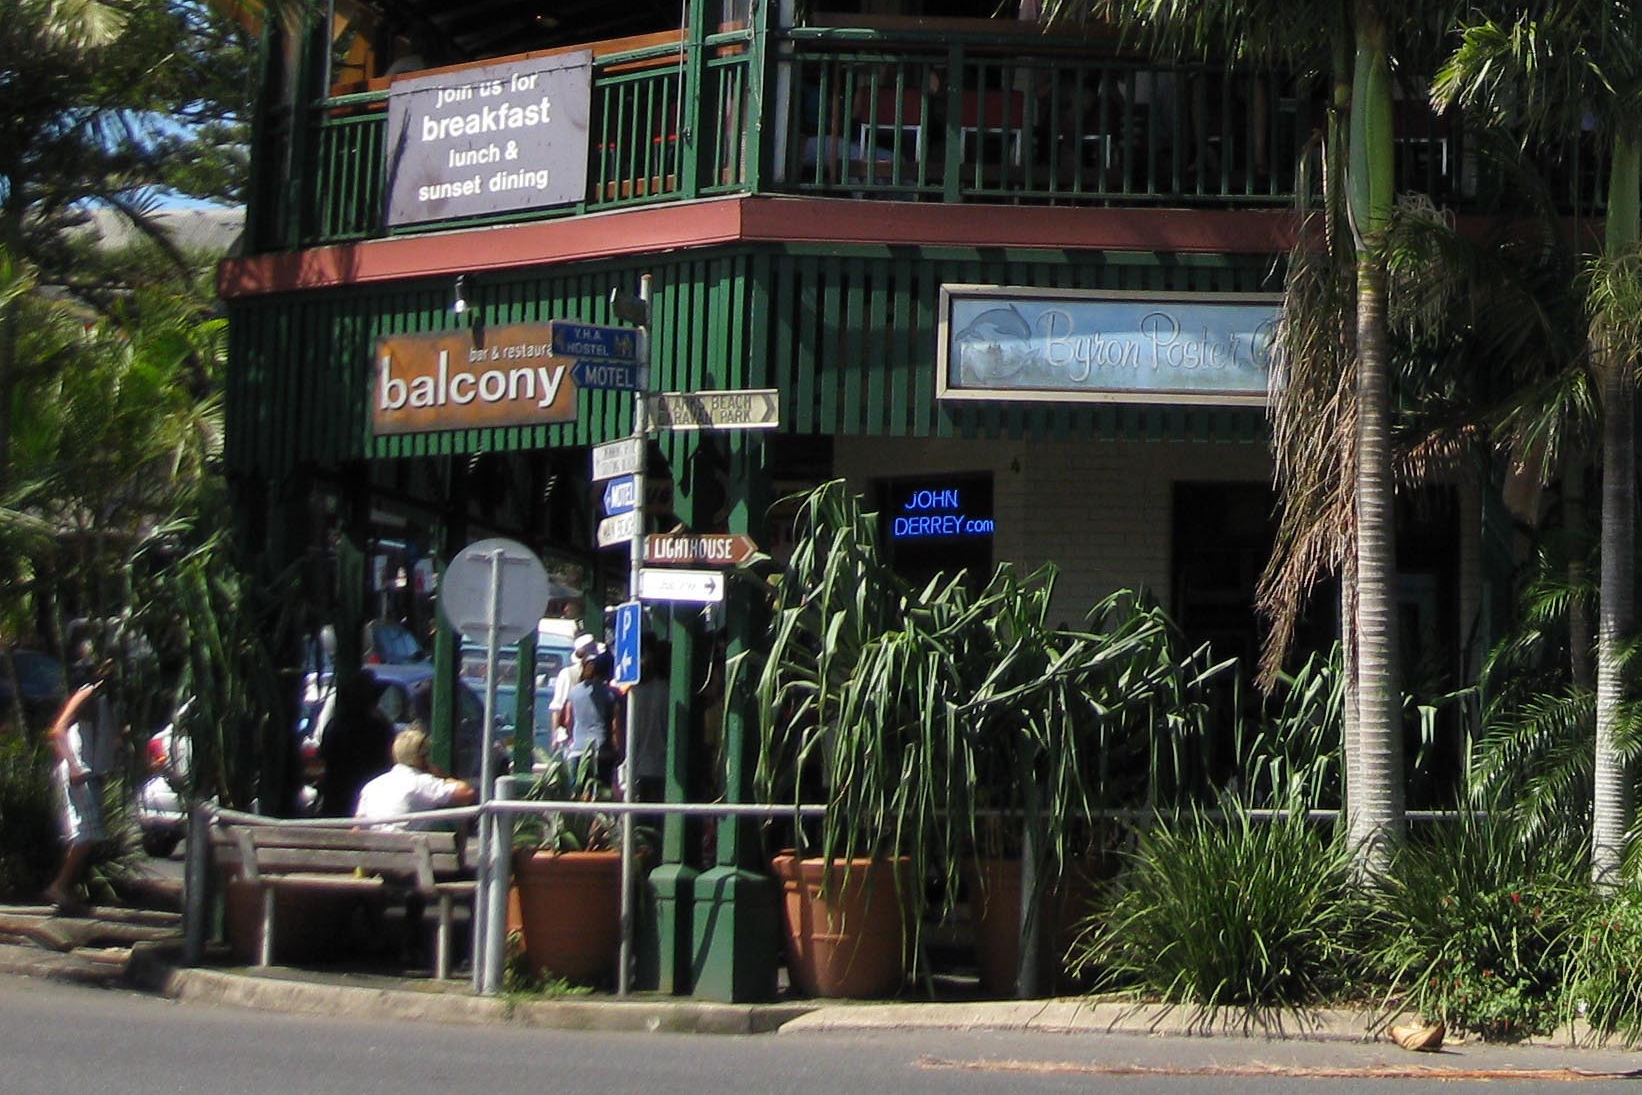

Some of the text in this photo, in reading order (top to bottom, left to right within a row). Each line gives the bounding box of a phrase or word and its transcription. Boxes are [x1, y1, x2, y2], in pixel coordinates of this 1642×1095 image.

[435, 73, 539, 109] join us for
[421, 96, 551, 142] breakfast
[448, 139, 519, 168] lunch &
[418, 167, 549, 202] sunset dining
[469, 342, 554, 363] bar & restaura
[566, 342, 609, 357] HOSTEL
[1035, 308, 1141, 383] Byron
[1139, 309, 1243, 374] Poster
[378, 349, 568, 411] balcony
[584, 364, 634, 388] MOTEL
[711, 393, 752, 411] BEACH
[720, 409, 752, 424] PARK
[904, 489, 959, 509] JOHN
[894, 514, 965, 536] DERREY
[654, 536, 734, 560] LIGHTHOUSE
[622, 609, 633, 641] P
